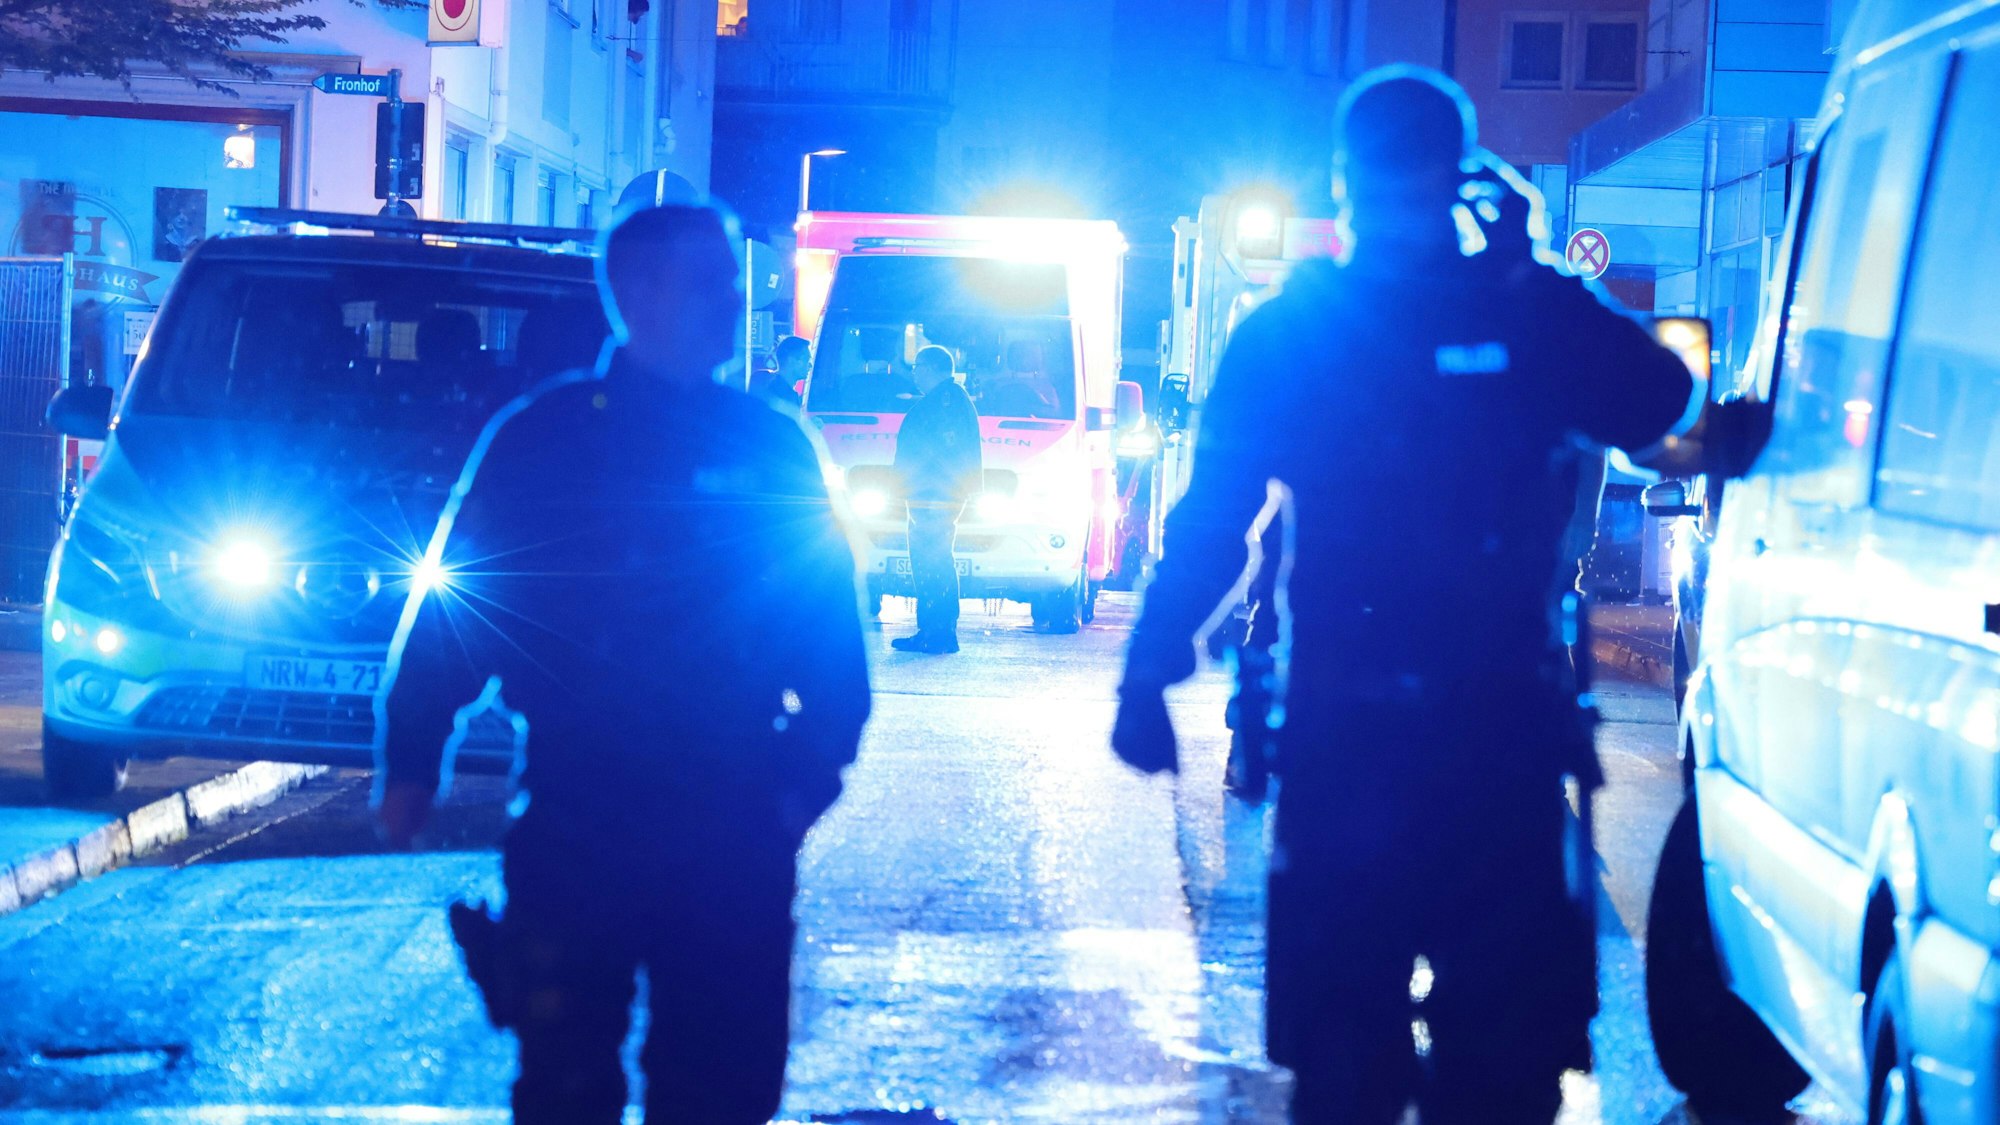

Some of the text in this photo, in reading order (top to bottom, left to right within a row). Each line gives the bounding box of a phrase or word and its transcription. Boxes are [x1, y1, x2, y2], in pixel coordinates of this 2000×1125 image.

[334, 77, 380, 92] Fronhof
[74, 267, 139, 291] HAUS
[261, 659, 308, 687] NRW
